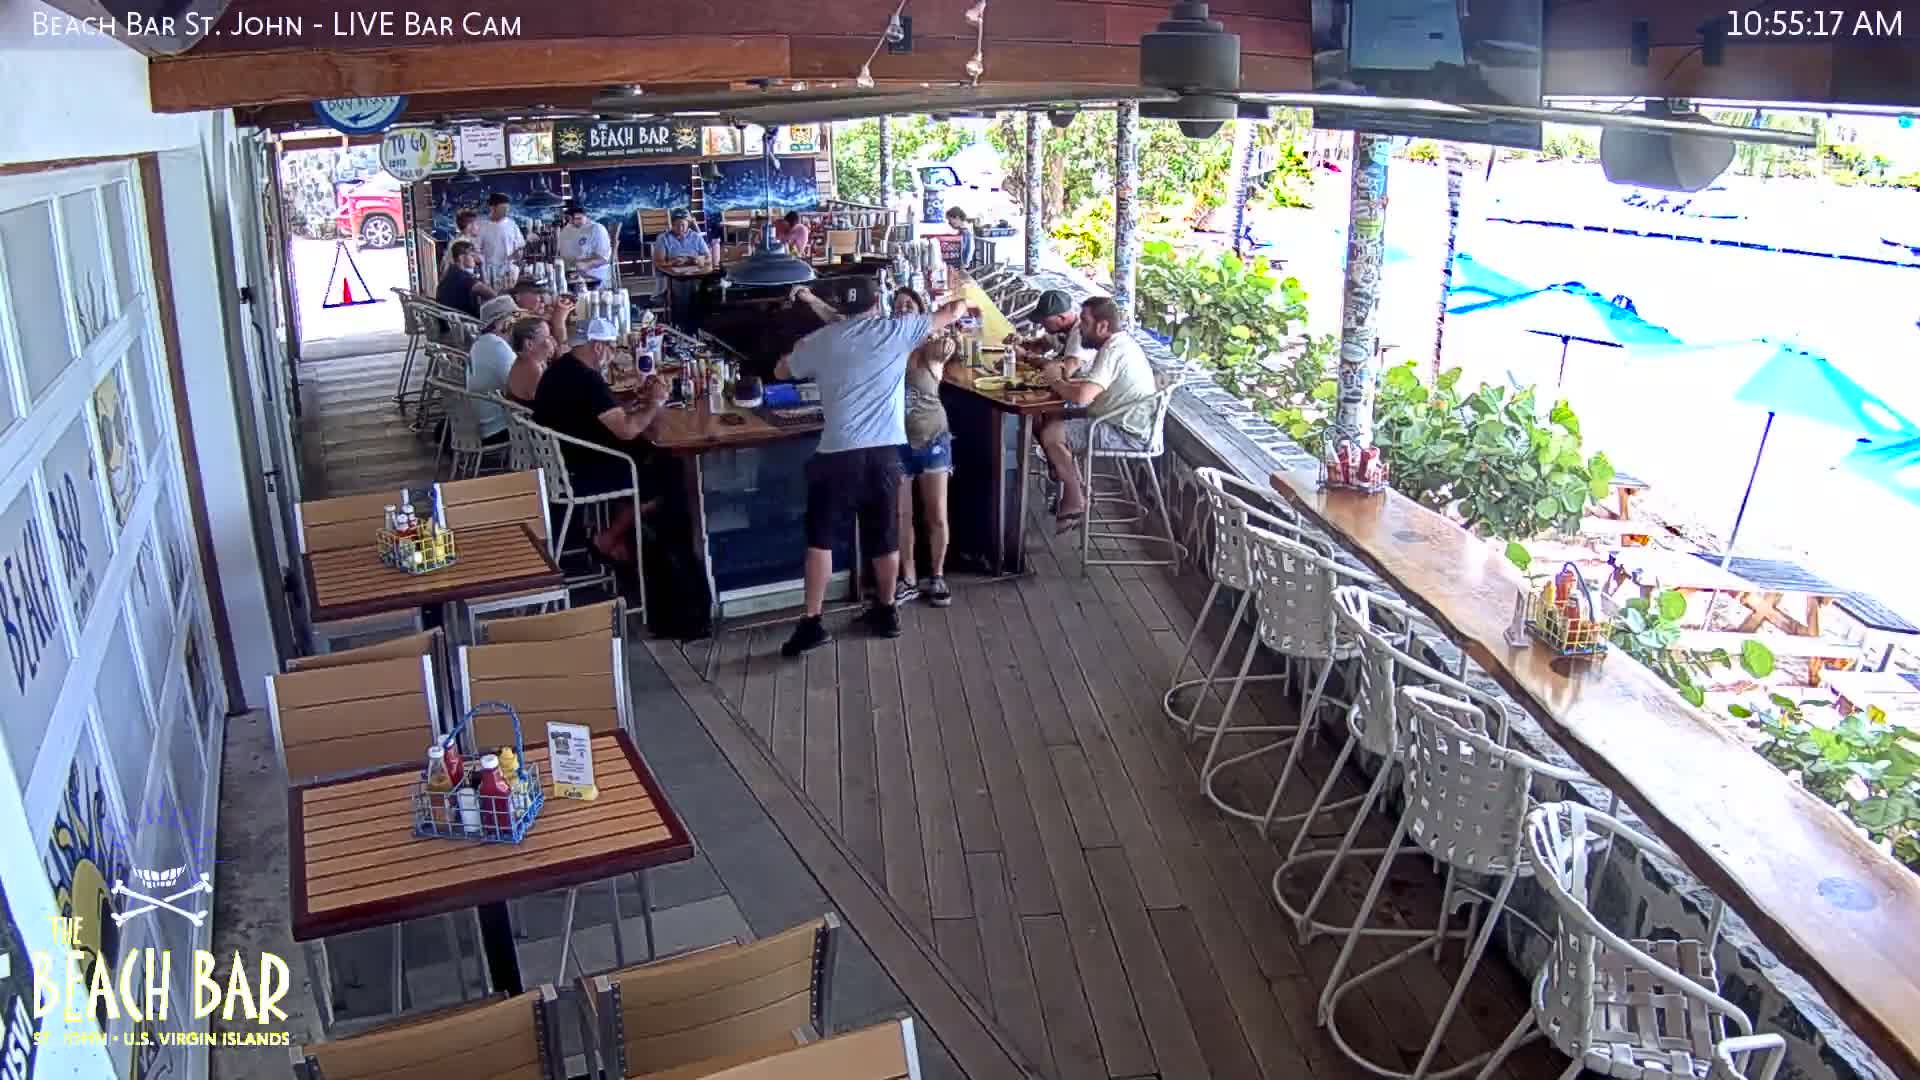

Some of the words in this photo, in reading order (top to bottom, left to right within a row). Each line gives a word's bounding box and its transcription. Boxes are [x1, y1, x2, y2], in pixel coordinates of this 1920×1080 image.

[388, 134, 405, 156] TO
[411, 132, 427, 152] GO
[590, 127, 633, 147] BEACH
[639, 126, 669, 144] BAR
[0, 517, 58, 696] BEACH
[49, 471, 88, 590] BAR
